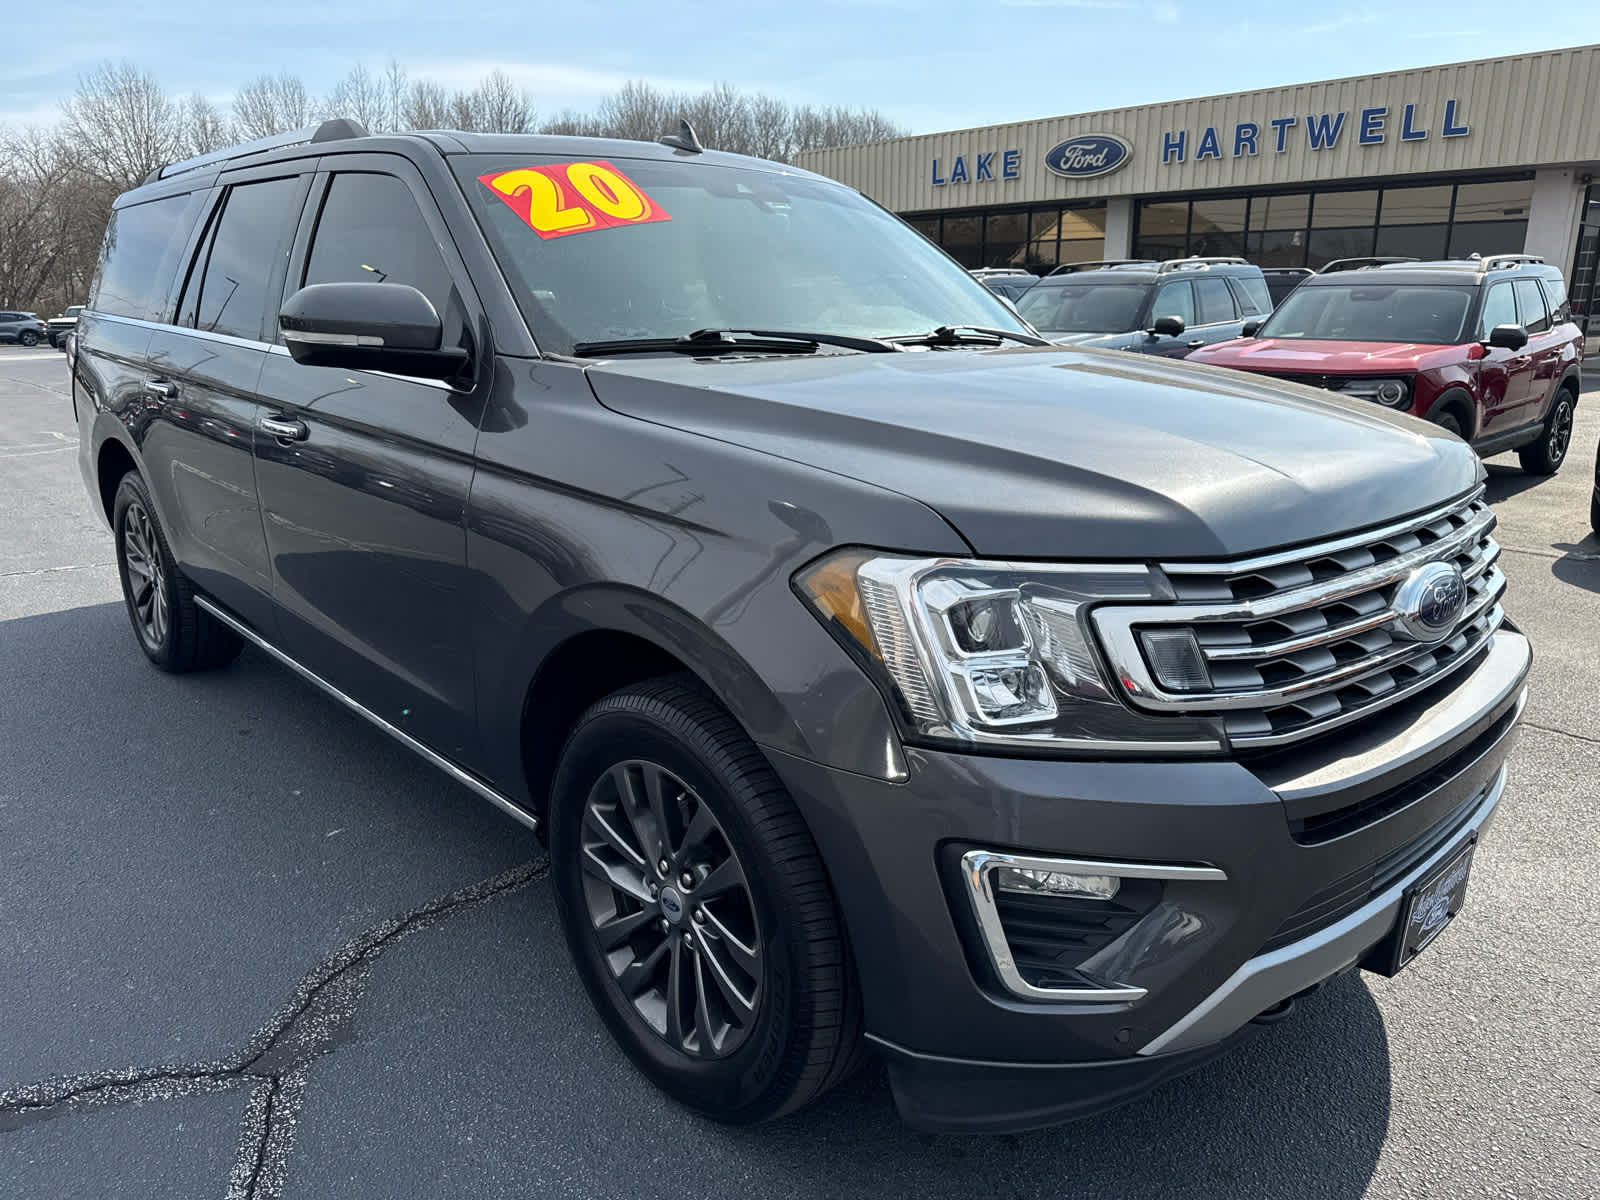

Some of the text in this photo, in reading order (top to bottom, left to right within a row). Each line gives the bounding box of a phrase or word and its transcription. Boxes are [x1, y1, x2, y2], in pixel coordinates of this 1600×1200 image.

[931, 99, 1470, 185] LAKE Ford HARTWELL
[490, 162, 652, 233] 20
